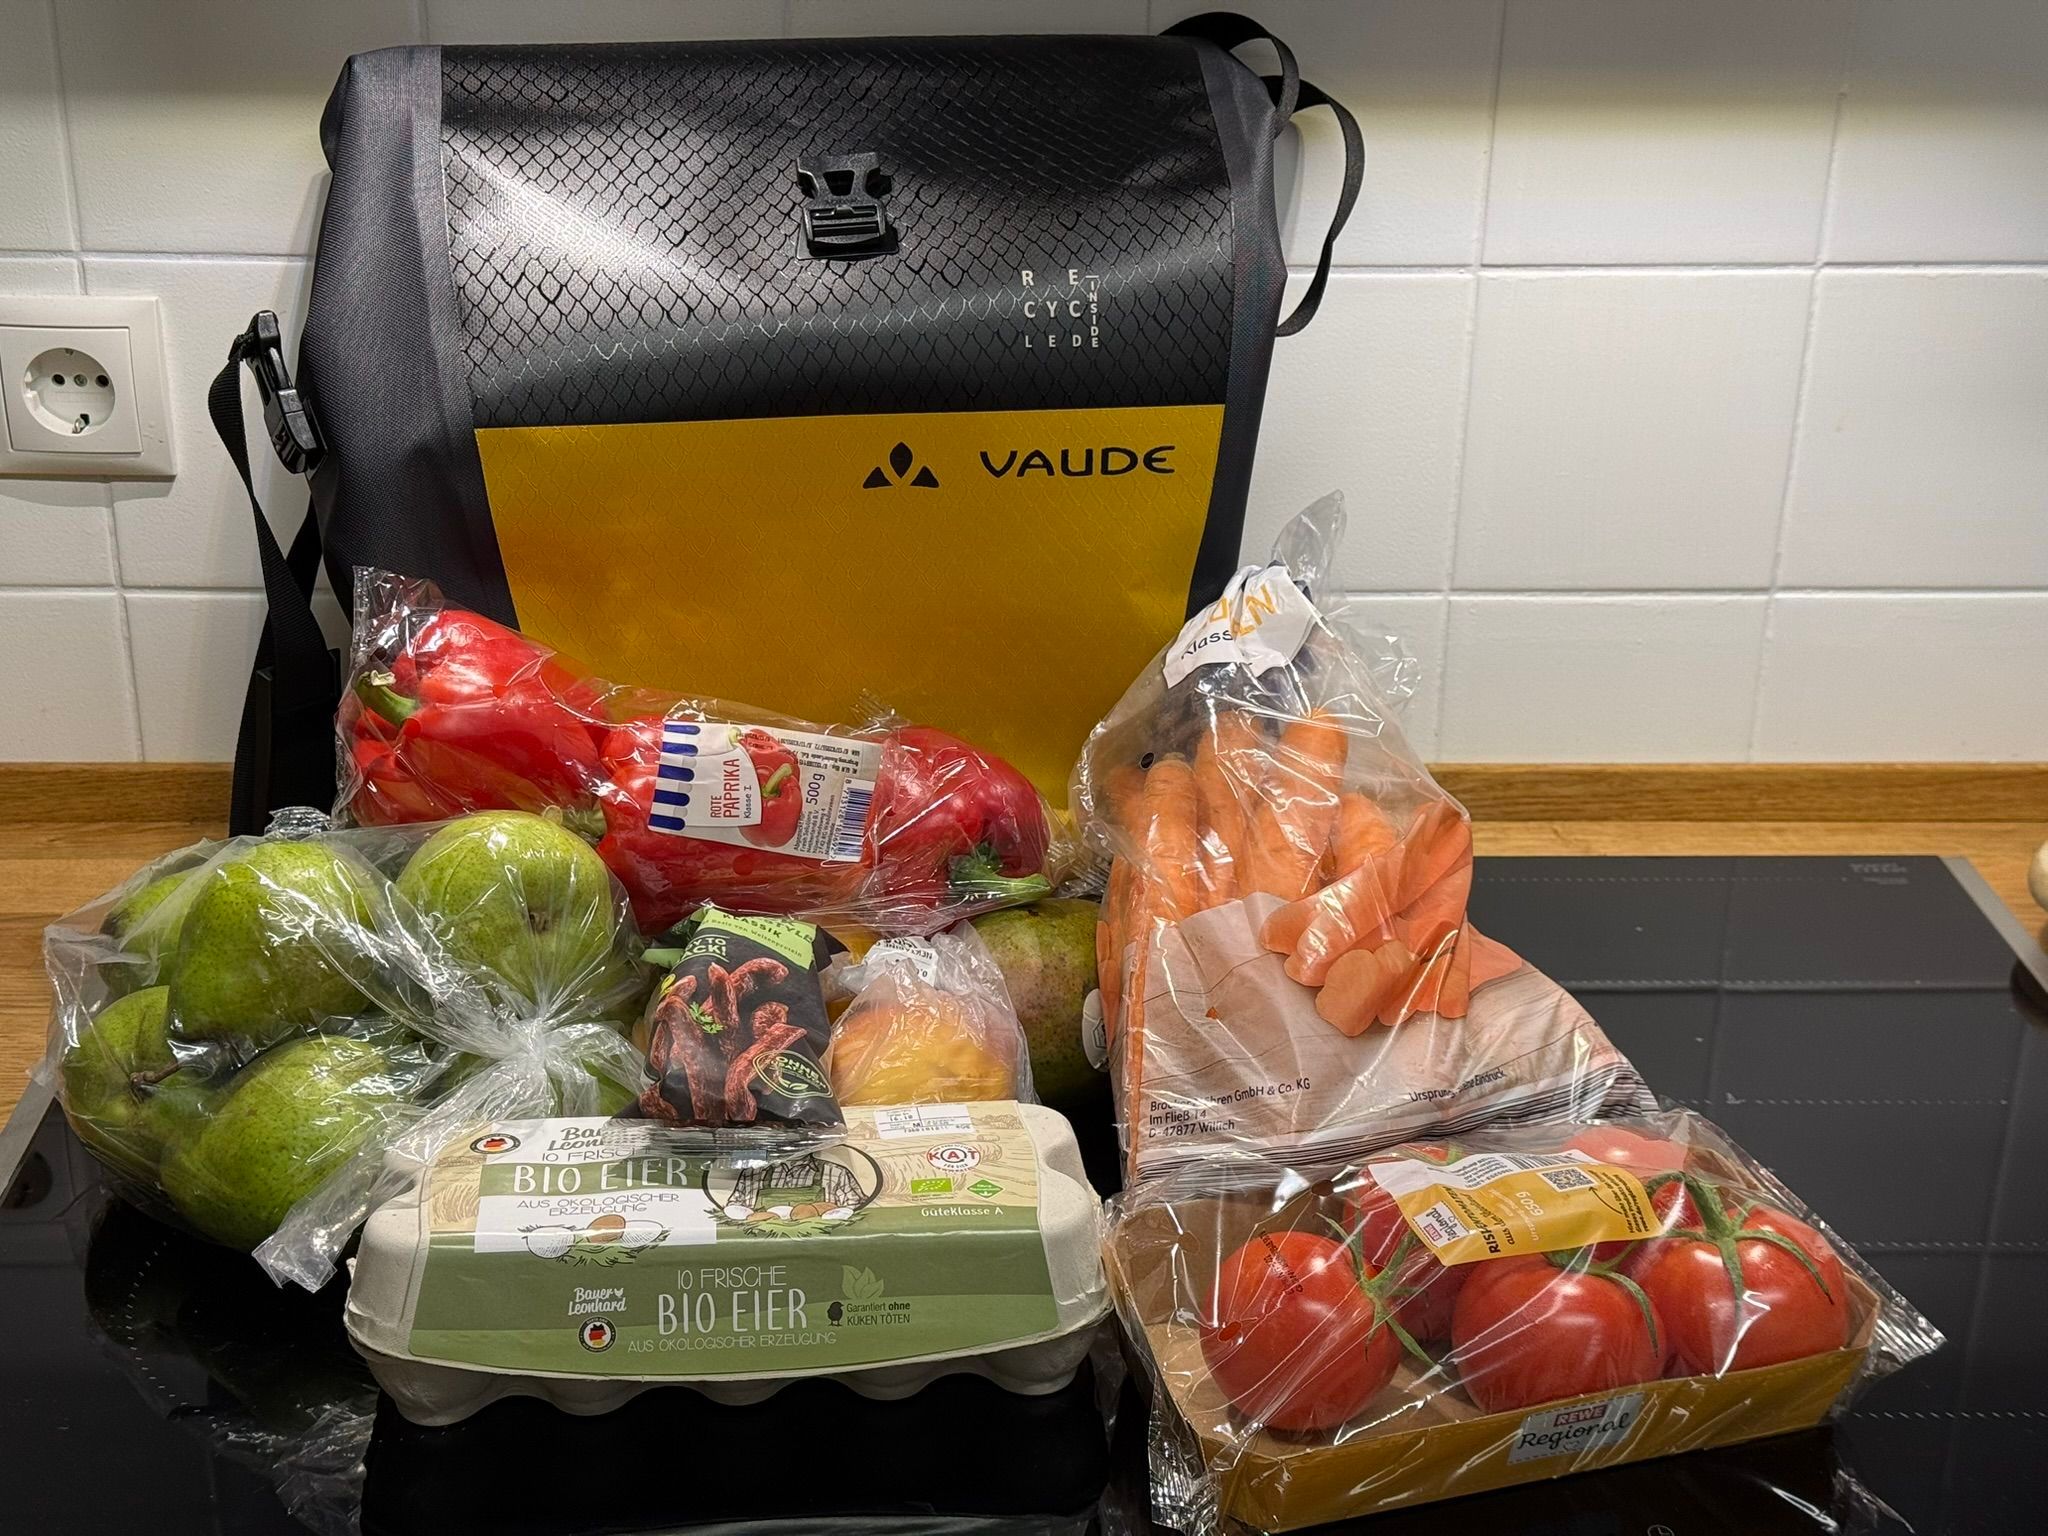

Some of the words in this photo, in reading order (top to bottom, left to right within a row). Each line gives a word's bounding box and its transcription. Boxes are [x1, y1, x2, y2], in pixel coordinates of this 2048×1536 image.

[979, 445, 1176, 478] VAUDE
[723, 758, 740, 818] PAPRIKA
[710, 795, 722, 818] ROTE
[743, 793, 752, 819] Klasse
[705, 937, 727, 945] TO
[1234, 1086, 1264, 1102] GmbH
[1267, 1085, 1276, 1096] &
[1277, 1082, 1295, 1095] Co.
[1296, 1077, 1311, 1090] KG
[1149, 1114, 1163, 1126] Im
[929, 1150, 978, 1161] KAT
[513, 1164, 582, 1194] BIO
[600, 1157, 689, 1191] EIER
[517, 1199, 551, 1209] AUS
[549, 1202, 648, 1217] ERZEUGUNG
[994, 1206, 1004, 1216] A
[1502, 1224, 1516, 1246] aus
[677, 1269, 694, 1290] 10
[700, 1265, 787, 1289] FRISCHE
[573, 1287, 614, 1303] Bauer
[567, 1297, 628, 1316] Leonhard
[657, 1292, 716, 1336] BIO
[732, 1288, 808, 1333] EIER
[846, 1302, 887, 1313] Garantiert
[888, 1301, 911, 1311] ohne
[880, 1312, 911, 1325] TÖTEN
[627, 1340, 655, 1353] AUS
[759, 1331, 838, 1348] ERZEUGUNG
[1556, 1404, 1608, 1426] REWE
[1517, 1412, 1631, 1450] Regional
